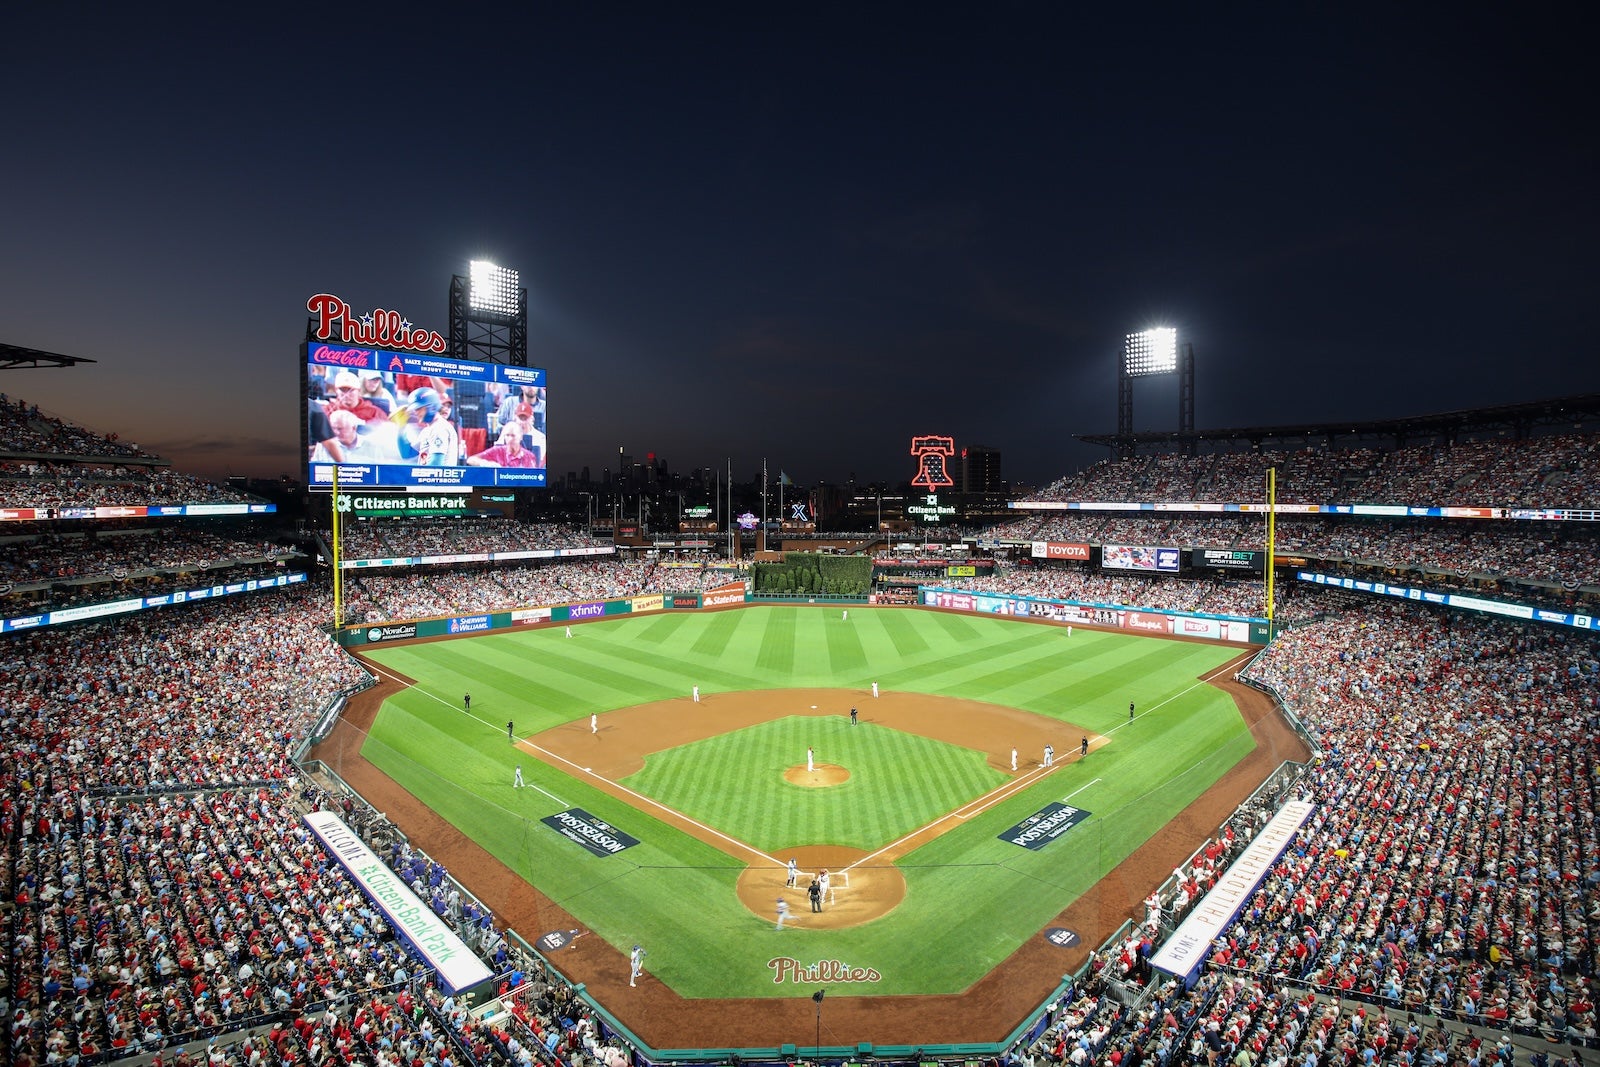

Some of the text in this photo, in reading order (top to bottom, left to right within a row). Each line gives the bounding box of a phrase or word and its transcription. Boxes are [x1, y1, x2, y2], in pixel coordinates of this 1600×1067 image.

[307, 294, 446, 353] Phillies
[314, 346, 370, 367] Coca-Cola
[411, 468, 466, 478] ESPN BET
[354, 496, 466, 509] Citizens Bank Park
[1049, 546, 1086, 556] TOYOTA
[1204, 550, 1255, 560] ESPN BET
[460, 616, 487, 625] SHERWIN
[571, 604, 603, 617] xfinity
[382, 625, 416, 636] NovaCare
[554, 812, 625, 852] POSTSEASON
[1012, 806, 1079, 846] POSTSEASON
[319, 821, 366, 861] WELCOME
[1169, 804, 1306, 961] HOME PHILADELPHIA PHILLIES
[366, 872, 456, 964] Citizens Bank Park
[767, 957, 881, 984] Phillies
